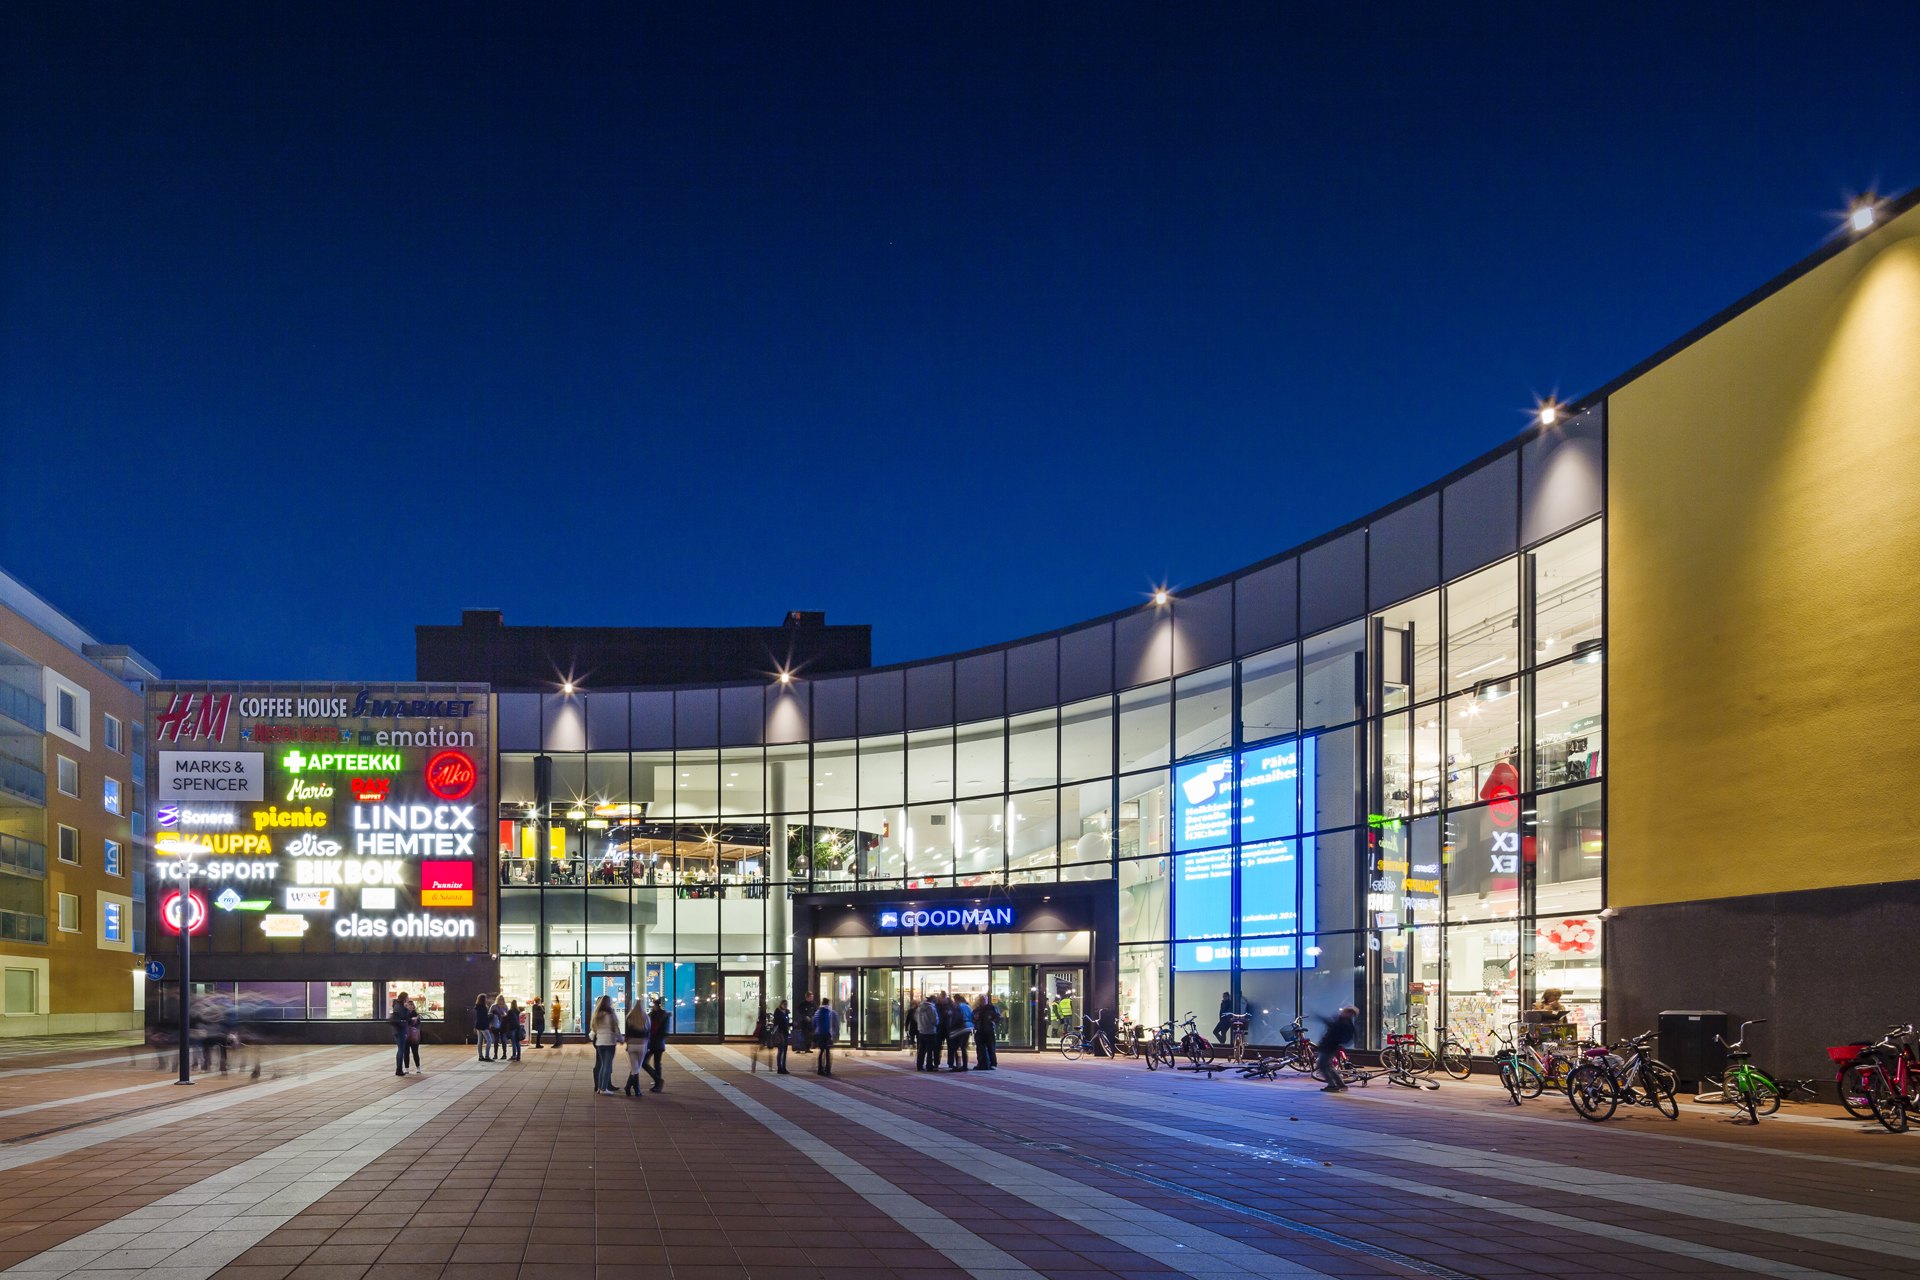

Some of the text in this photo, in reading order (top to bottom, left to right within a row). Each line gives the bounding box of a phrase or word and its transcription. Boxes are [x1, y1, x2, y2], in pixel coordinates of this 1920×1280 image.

[156, 693, 233, 744] H&M
[239, 697, 347, 718] COFFEE HOUSE
[370, 700, 474, 718] MARKET
[375, 725, 474, 747] emotion
[176, 760, 245, 773] MARKS &
[307, 753, 401, 771] APTEEKKI
[172, 777, 248, 791] SPENCER
[351, 777, 391, 794] RAX
[433, 763, 471, 787] Alko
[287, 778, 334, 801] Mario
[181, 810, 234, 824] Sonera
[253, 806, 327, 831] picnic
[354, 805, 475, 830] LINDEX
[183, 833, 272, 855] KAUPPA
[286, 833, 342, 857] elisa
[357, 832, 474, 855] HEMTEX
[295, 859, 404, 885] BIK BOK
[432, 881, 463, 889] Punnitse
[335, 913, 475, 937] clas ohlson
[900, 908, 1011, 928] GOODMAN
